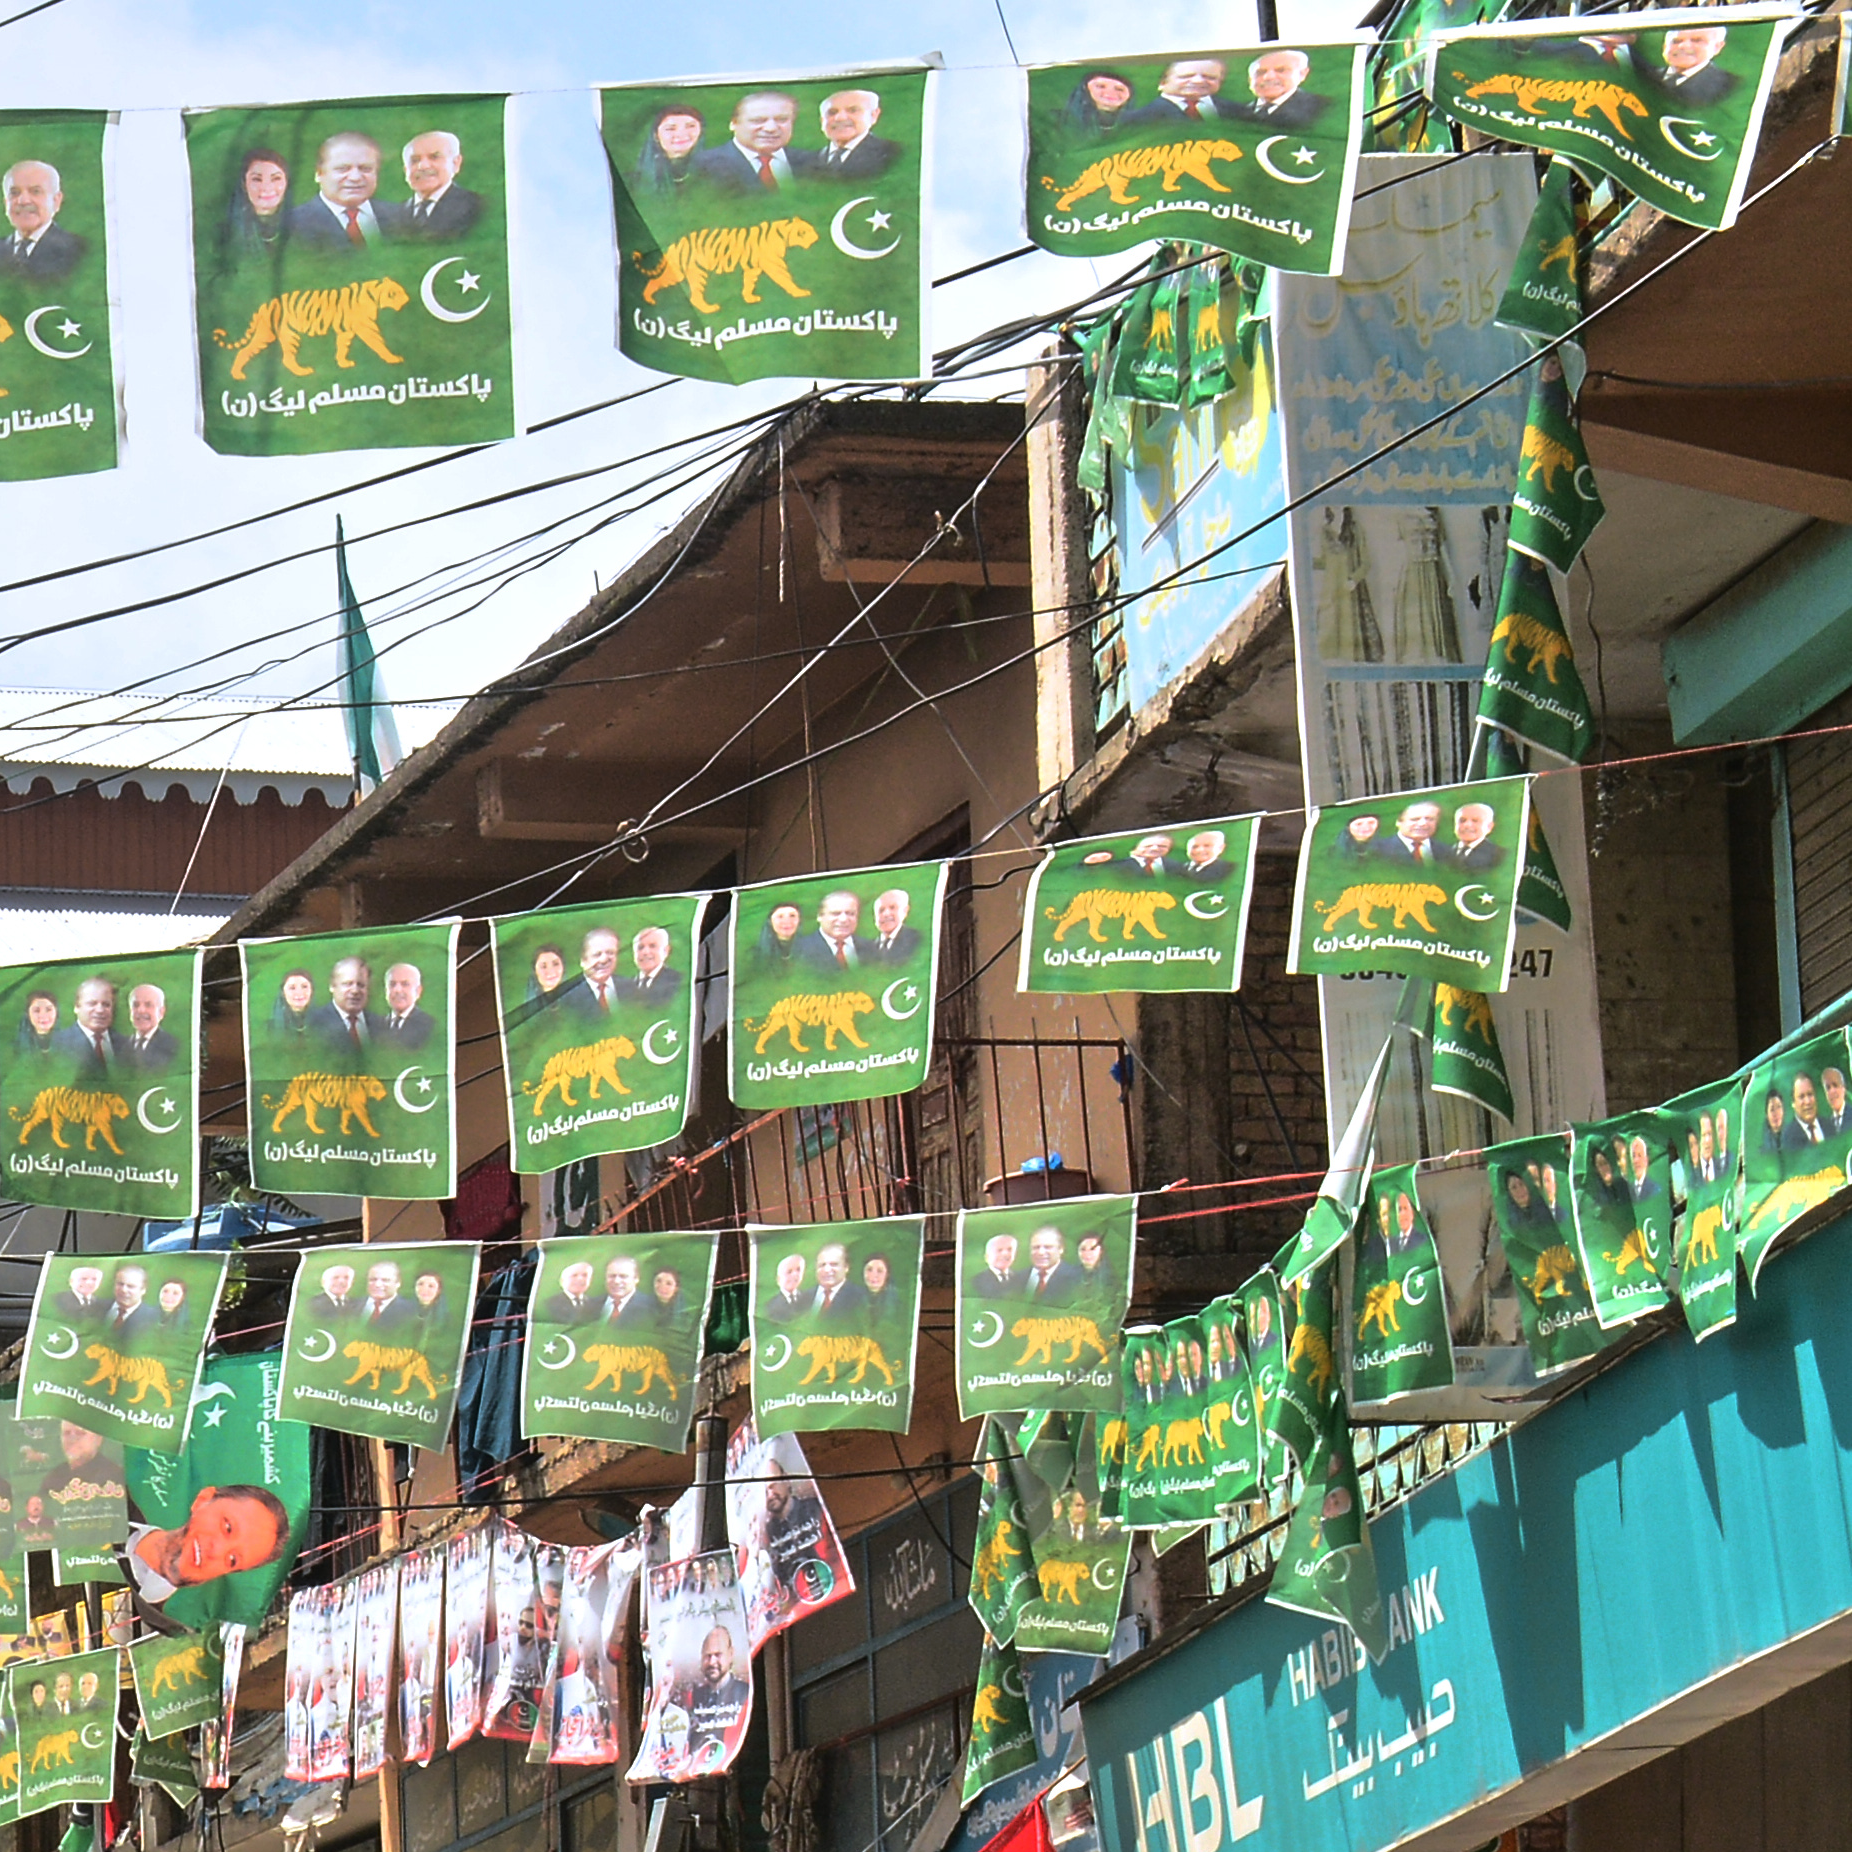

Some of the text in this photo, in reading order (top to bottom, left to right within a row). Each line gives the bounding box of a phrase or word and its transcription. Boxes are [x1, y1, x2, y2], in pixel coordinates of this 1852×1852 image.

[1082, 210, 1130, 232] لیگ
[1131, 199, 1212, 225] مسلم
[1211, 203, 1313, 245] پاکستان
[1068, 946, 1101, 967] لیگ
[1100, 947, 1152, 967] مسلم
[1152, 946, 1222, 965] پاکستان
[1387, 1565, 1445, 1652] ANK
[1301, 1678, 1456, 1801] حبیب بینک
